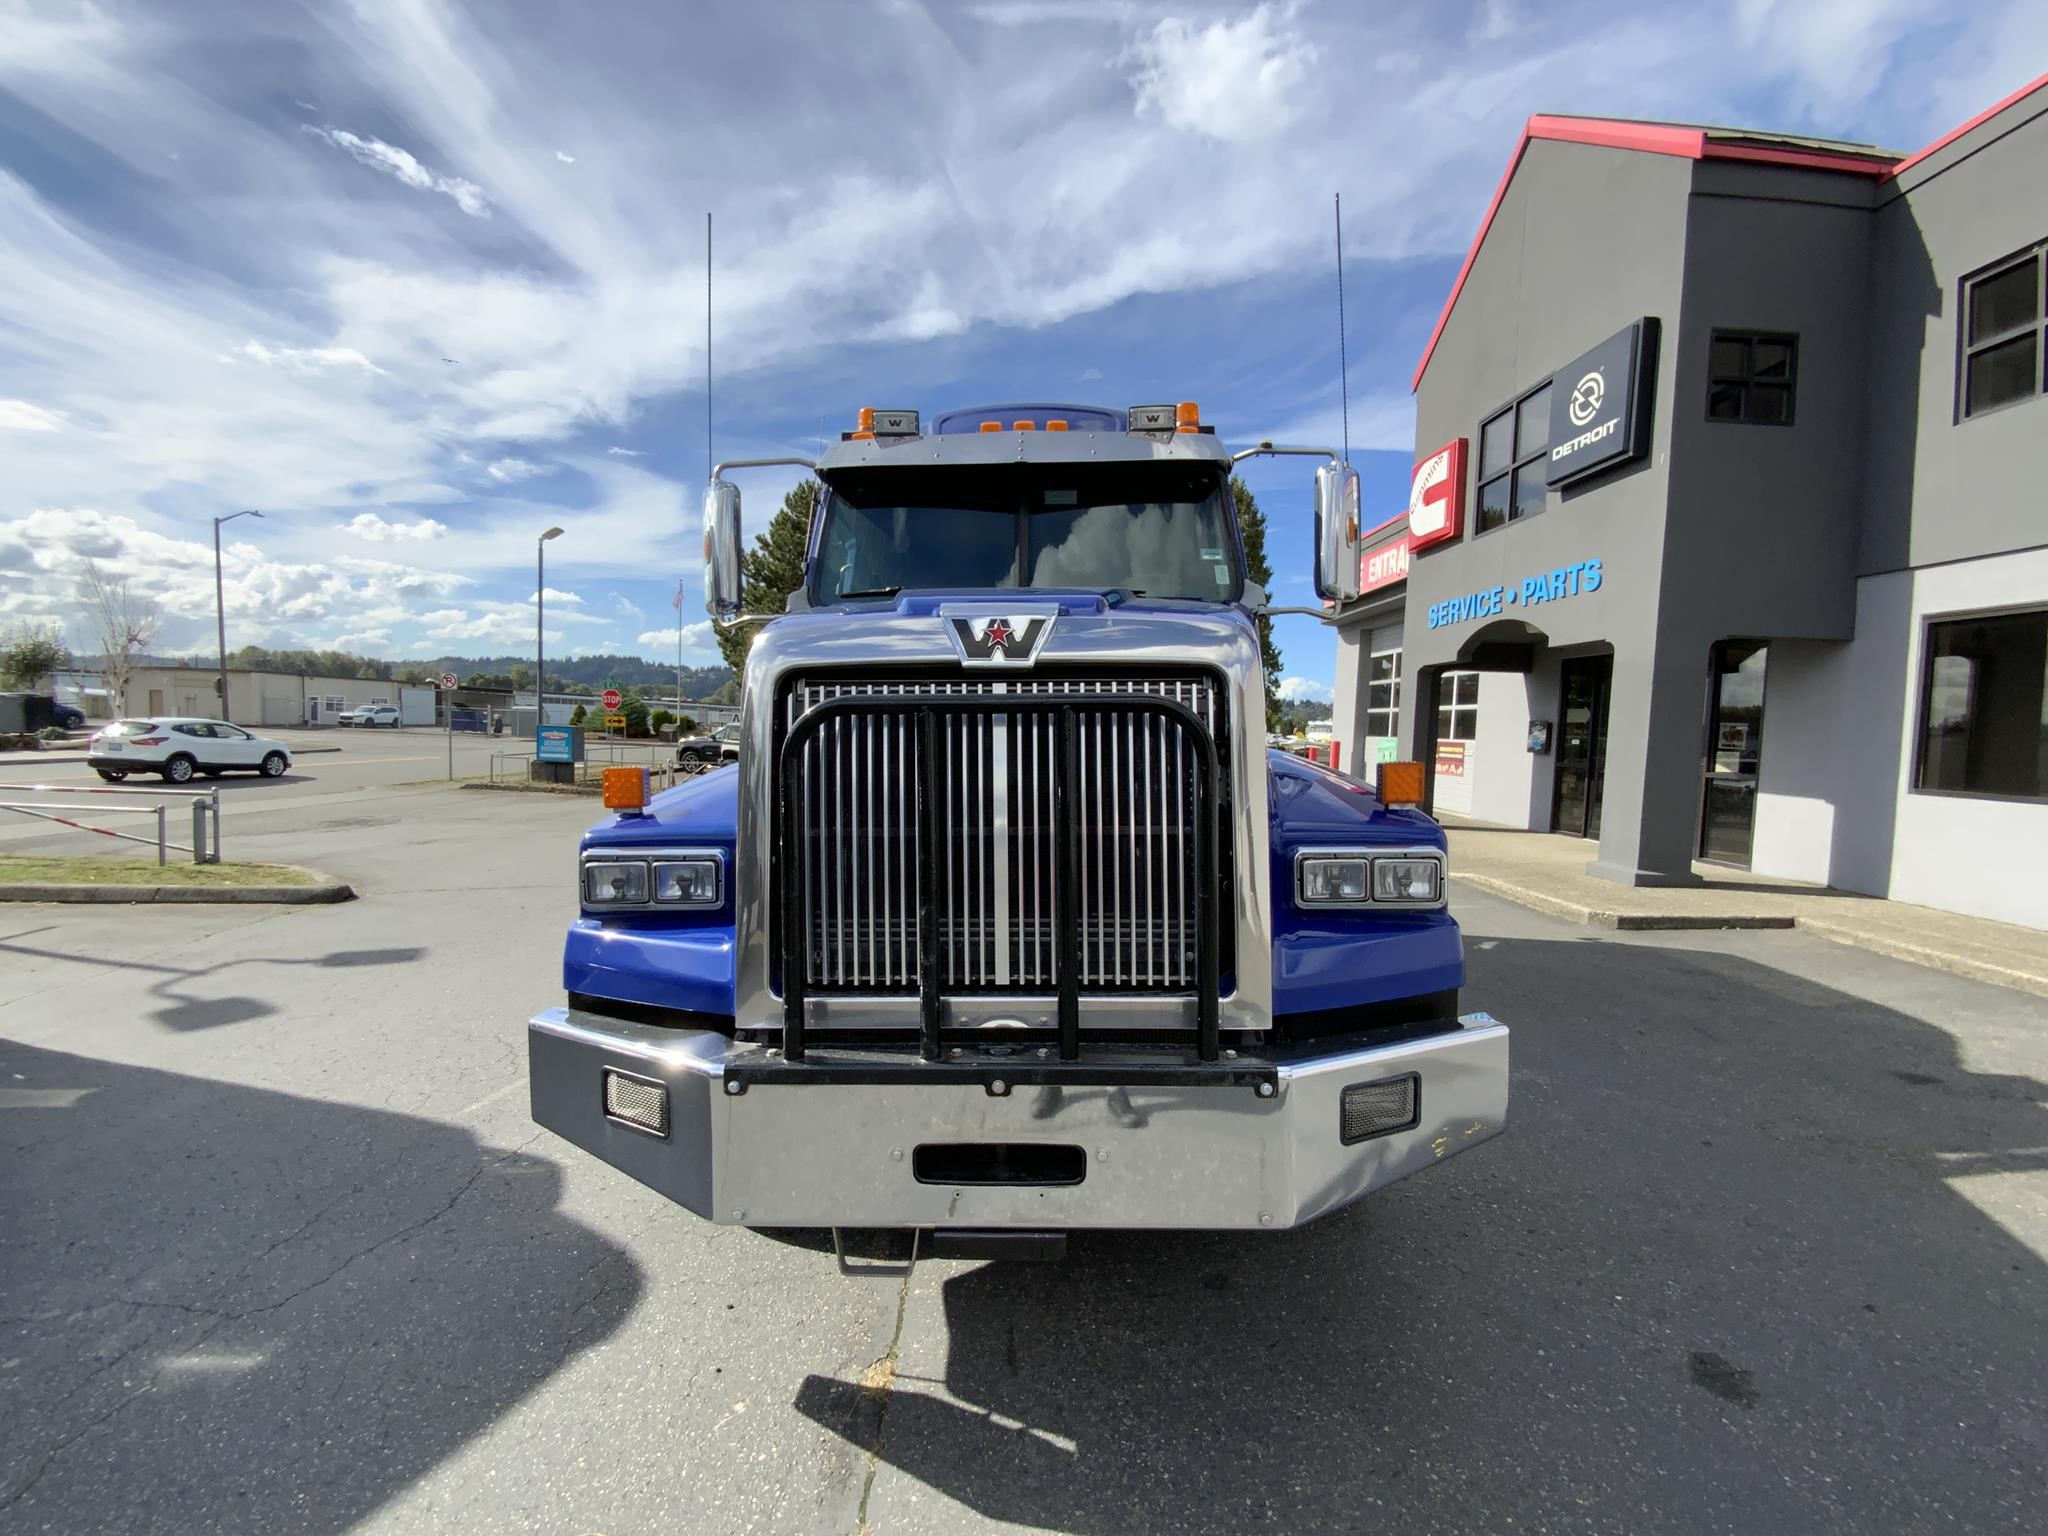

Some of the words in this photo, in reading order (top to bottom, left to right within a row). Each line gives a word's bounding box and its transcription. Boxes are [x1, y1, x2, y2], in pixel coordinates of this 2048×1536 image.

[1552, 419, 1618, 461] DETROIT
[1427, 585, 1504, 629] SERVICE
[1521, 558, 1602, 607] PARTS
[603, 695, 621, 704] STOP
